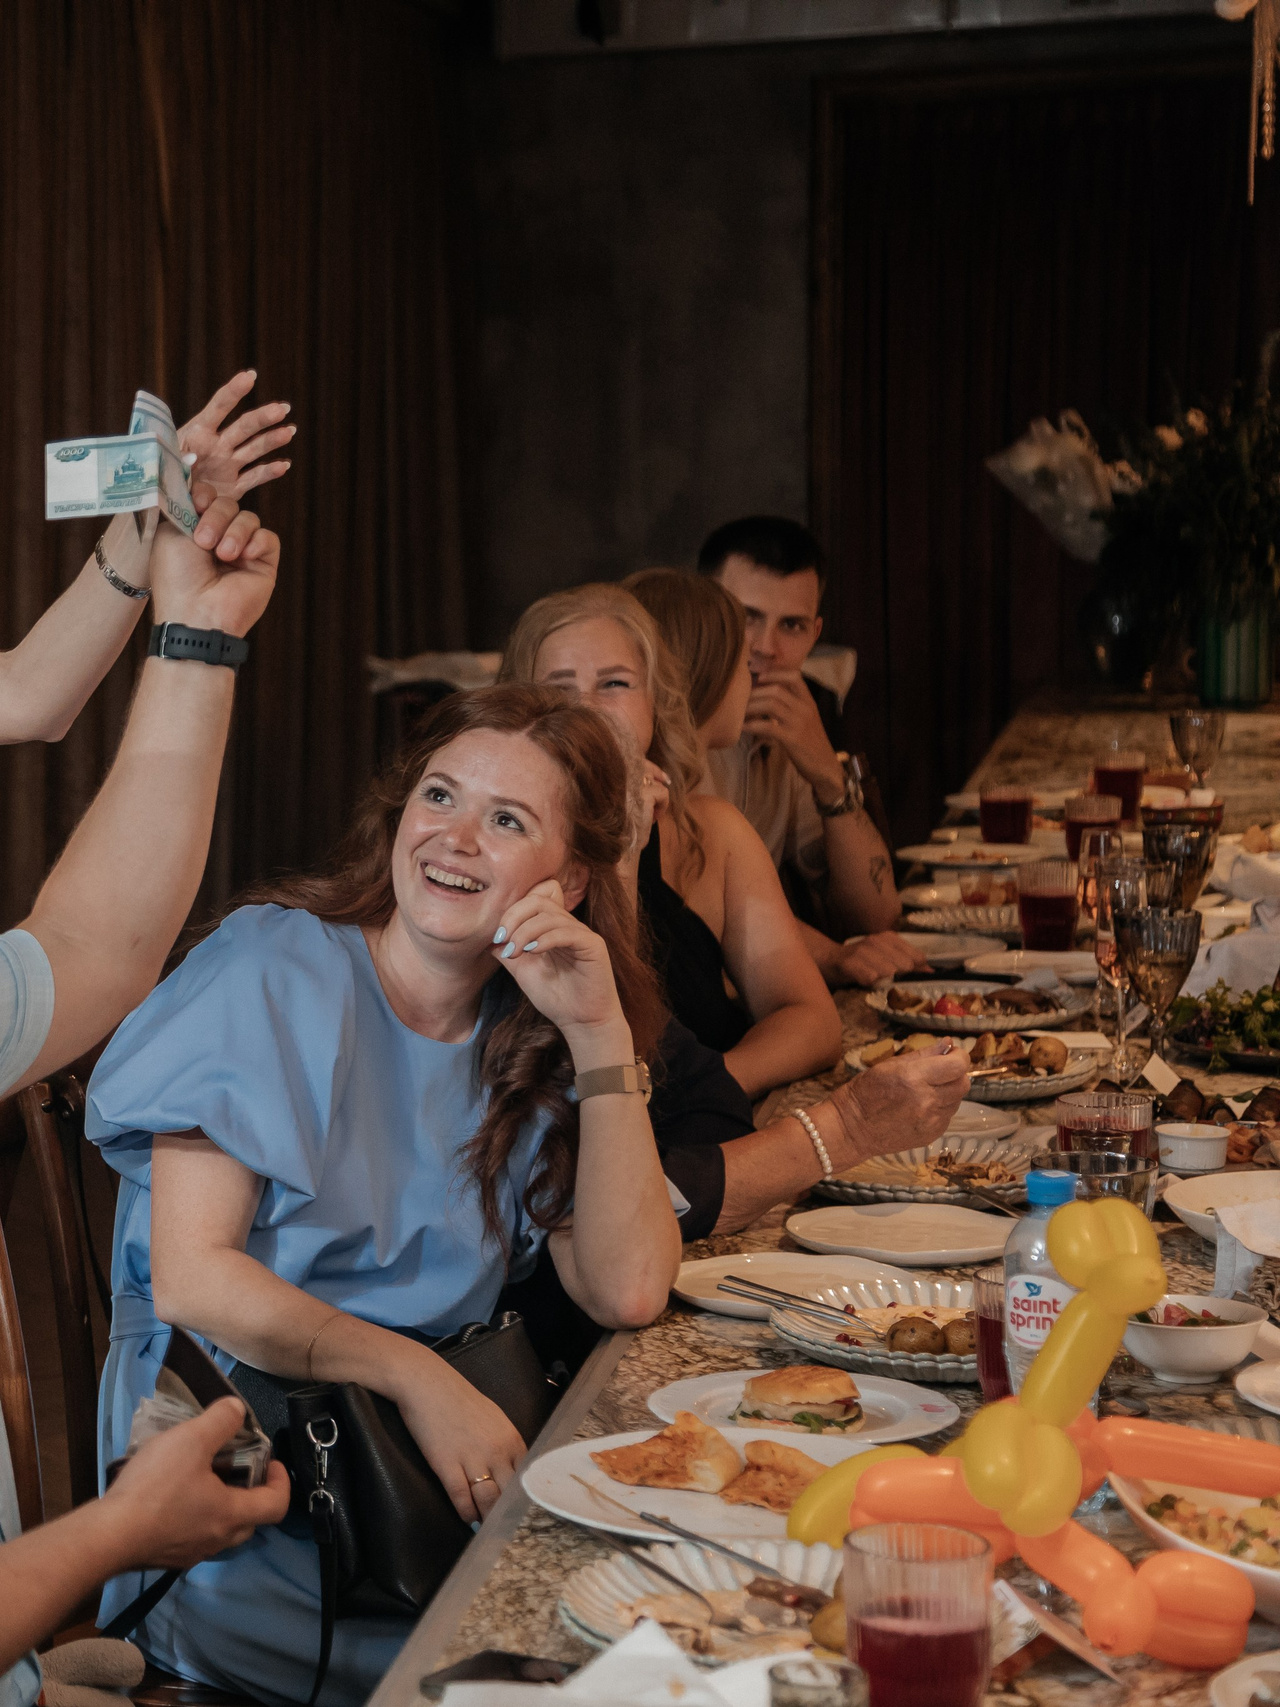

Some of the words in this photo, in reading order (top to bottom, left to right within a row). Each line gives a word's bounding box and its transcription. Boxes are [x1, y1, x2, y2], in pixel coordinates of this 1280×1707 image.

[61, 447, 84, 456] 1000
[1013, 1297, 1061, 1314] saint
[1010, 1311, 1054, 1331] sprin
